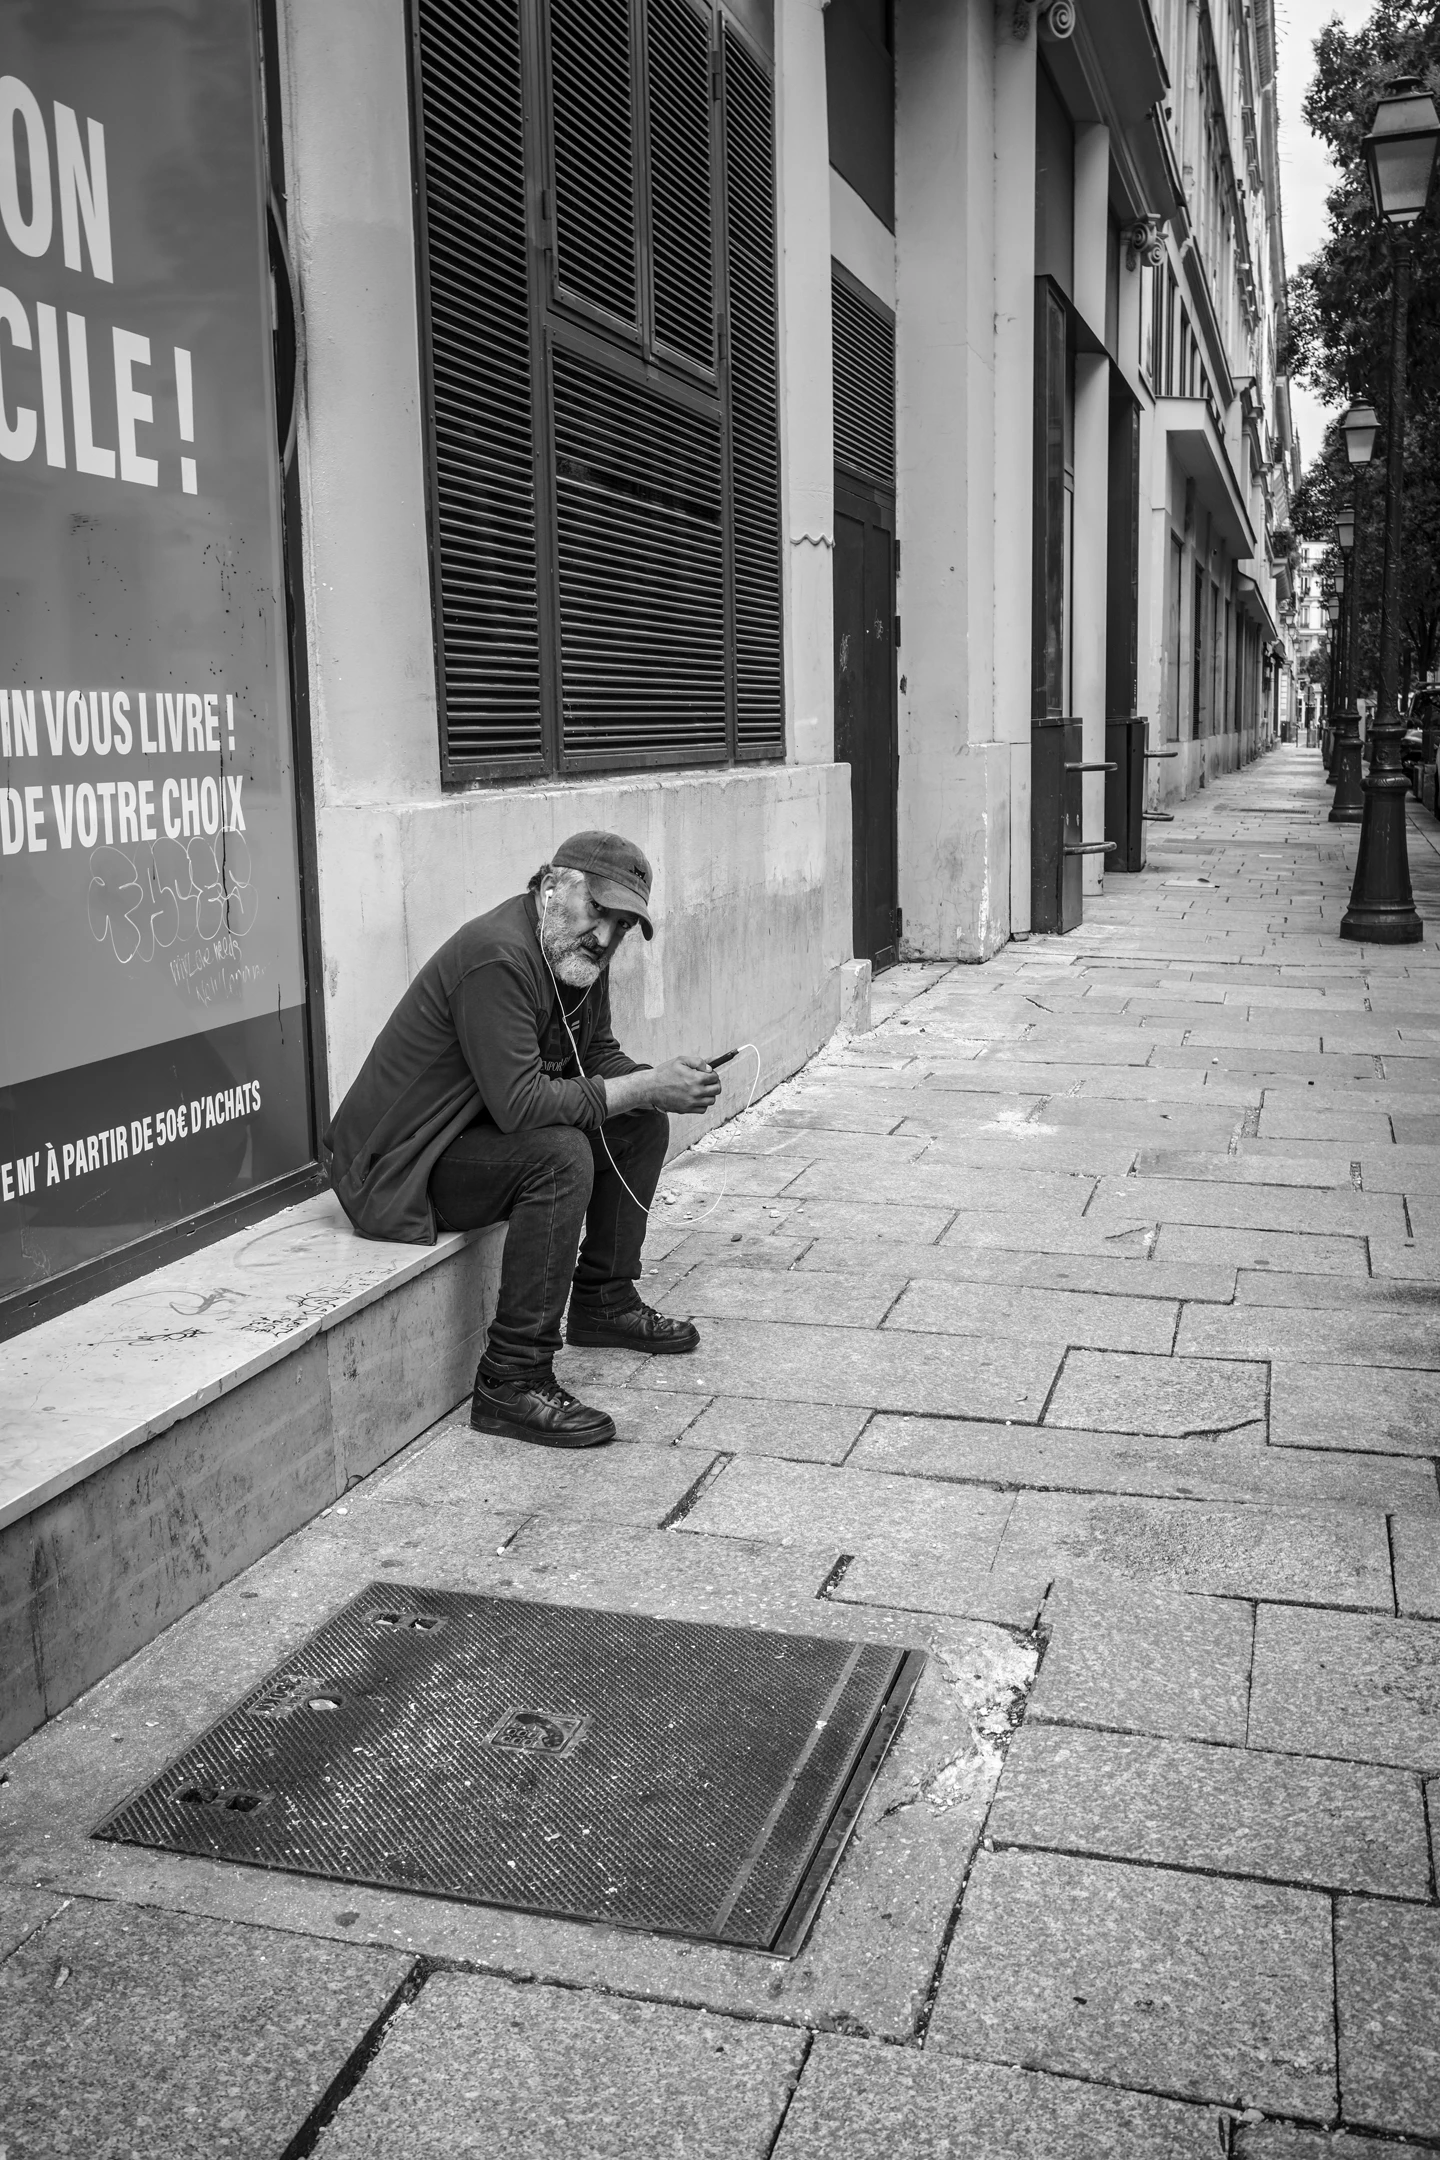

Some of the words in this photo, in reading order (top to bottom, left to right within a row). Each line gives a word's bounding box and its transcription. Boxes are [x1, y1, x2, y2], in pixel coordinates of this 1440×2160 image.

[0, 75, 114, 284] ON
[41, 690, 133, 756] VOUS
[0, 786, 47, 855] DE
[51, 780, 157, 849] VOTRE
[162, 775, 246, 839] CHOIX
[45, 1142, 60, 1187] À
[62, 1125, 129, 1180] PARTIR
[131, 1116, 154, 1155] DE
[156, 1104, 188, 1147] 50€
[190, 1079, 261, 1134] D'ACHATS
